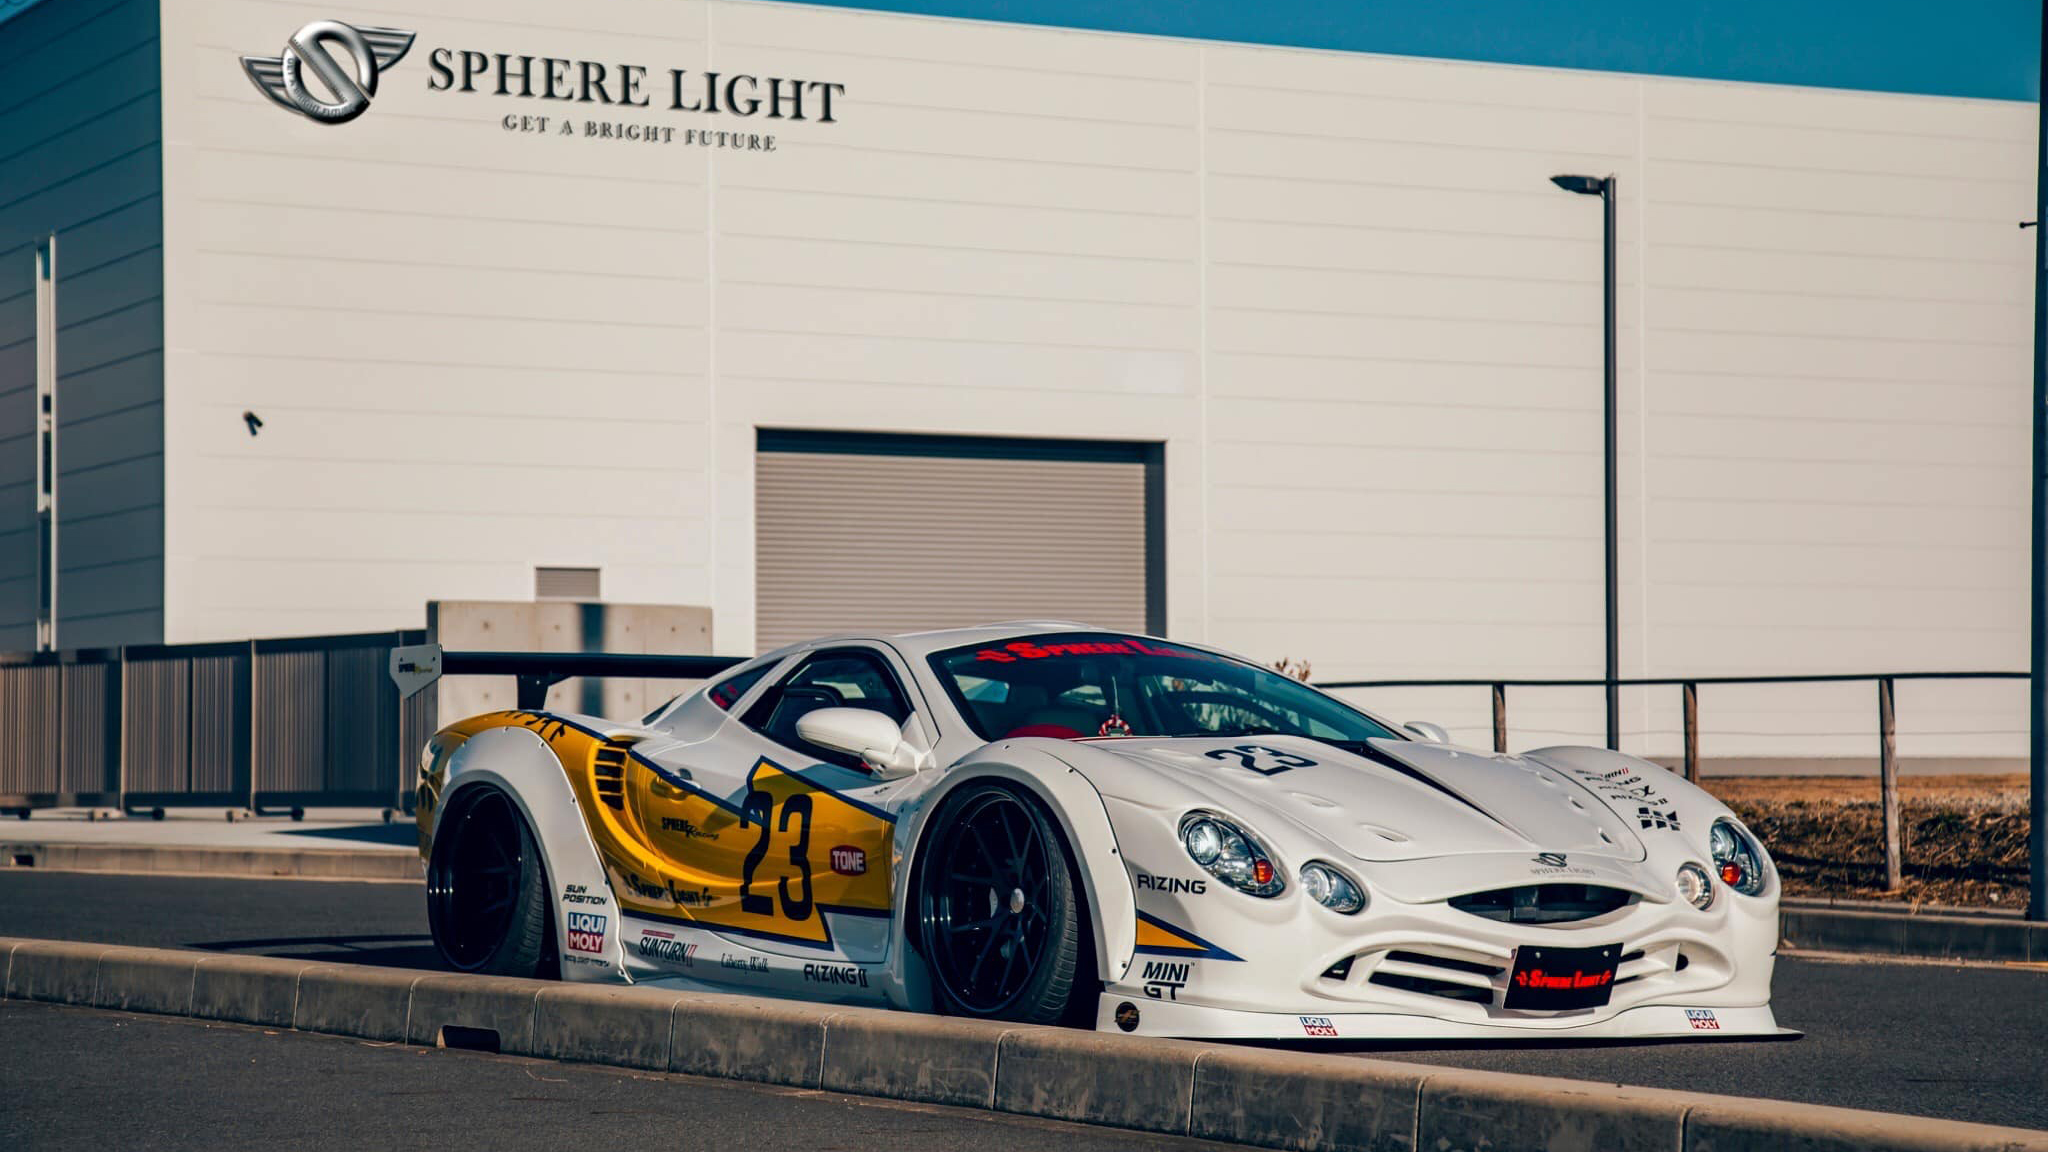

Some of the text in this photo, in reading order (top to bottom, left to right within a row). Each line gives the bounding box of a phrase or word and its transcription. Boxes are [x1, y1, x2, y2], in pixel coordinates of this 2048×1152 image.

[427, 47, 846, 123] SPHERE LIGHT
[502, 114, 777, 151] GET A BRIGHT FUTURE
[1204, 745, 1319, 776] 23
[740, 790, 813, 921] 23
[832, 850, 865, 871] TONE
[566, 884, 587, 893] SUN
[1137, 874, 1206, 895] RIZING
[562, 894, 607, 905] POSITION
[569, 913, 605, 933] LIQUI
[569, 933, 603, 952] MOLY
[639, 937, 690, 962] SUNTURN
[803, 963, 858, 985] RIZING
[1141, 961, 1190, 982] MINI
[1143, 981, 1186, 1000] GT
[1300, 1017, 1334, 1027] LIQUI
[1685, 1009, 1715, 1020] LIQUI
[1690, 1018, 1720, 1029] MOLY
[1304, 1025, 1338, 1036] MOLY
